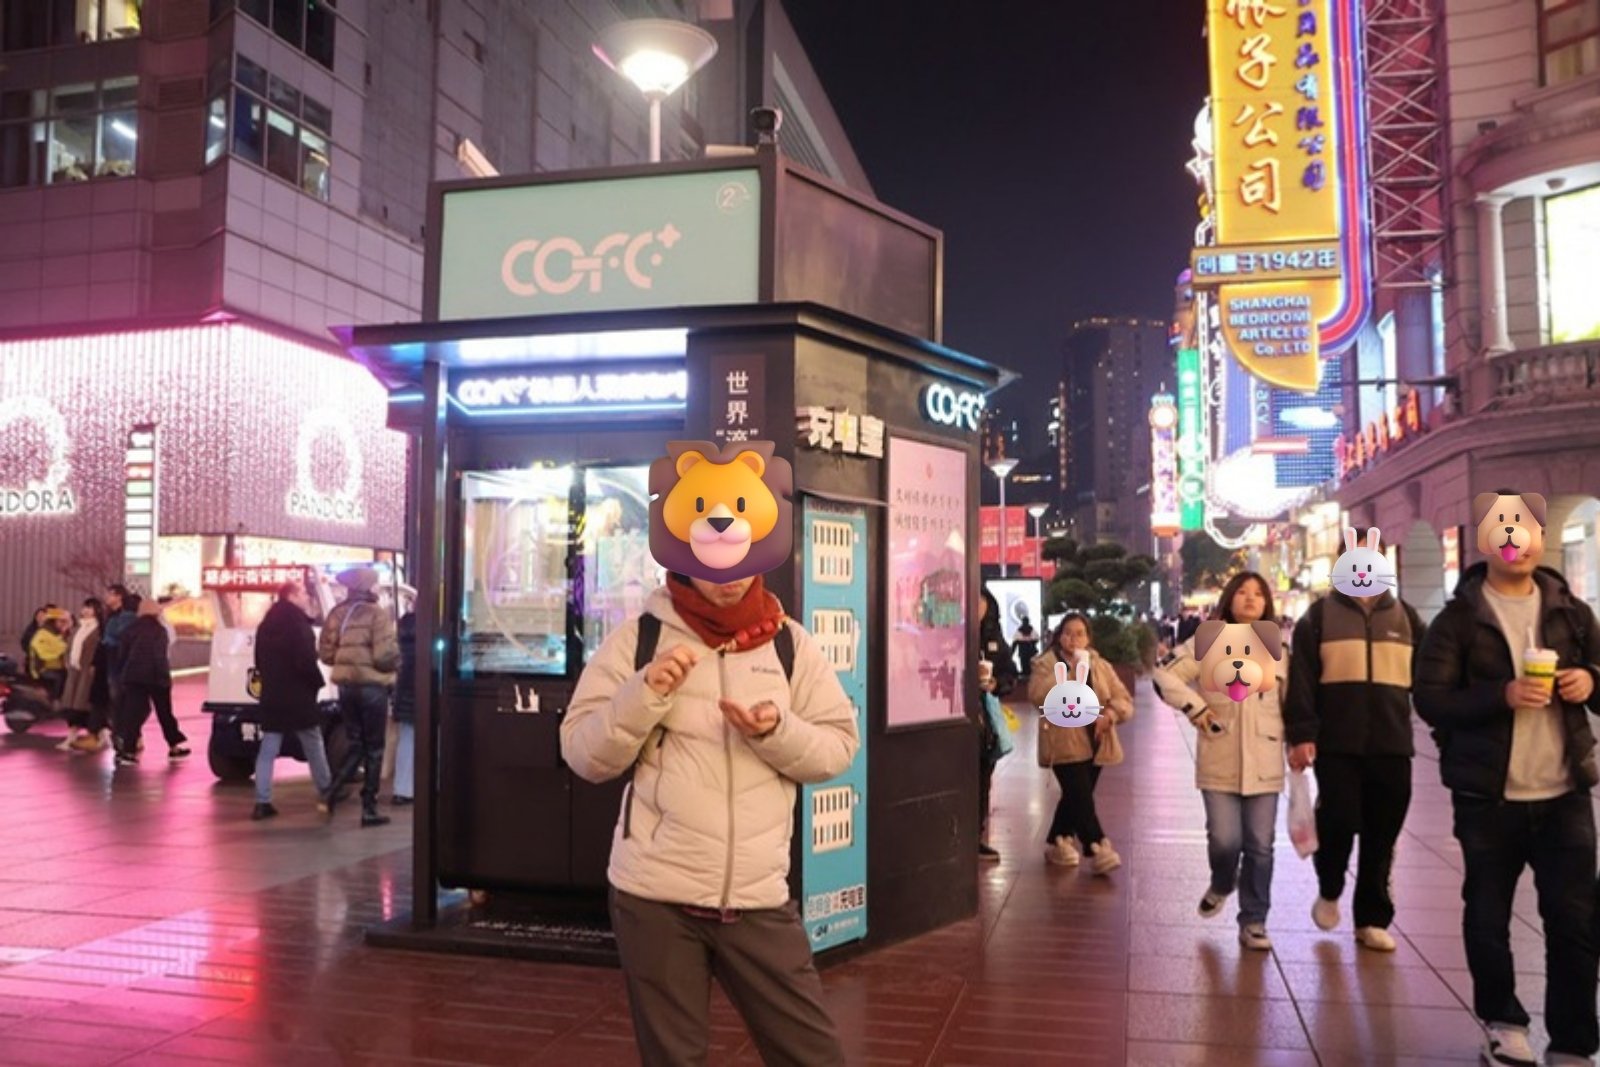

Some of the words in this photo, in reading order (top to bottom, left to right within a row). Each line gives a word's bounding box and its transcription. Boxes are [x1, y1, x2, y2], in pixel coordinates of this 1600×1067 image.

[1294, 0, 1325, 191] 用品有限公司
[1230, 296, 1311, 310] SHANGHAI
[1230, 312, 1311, 326] BEDROOM
[1240, 327, 1310, 341] ARTICLES
